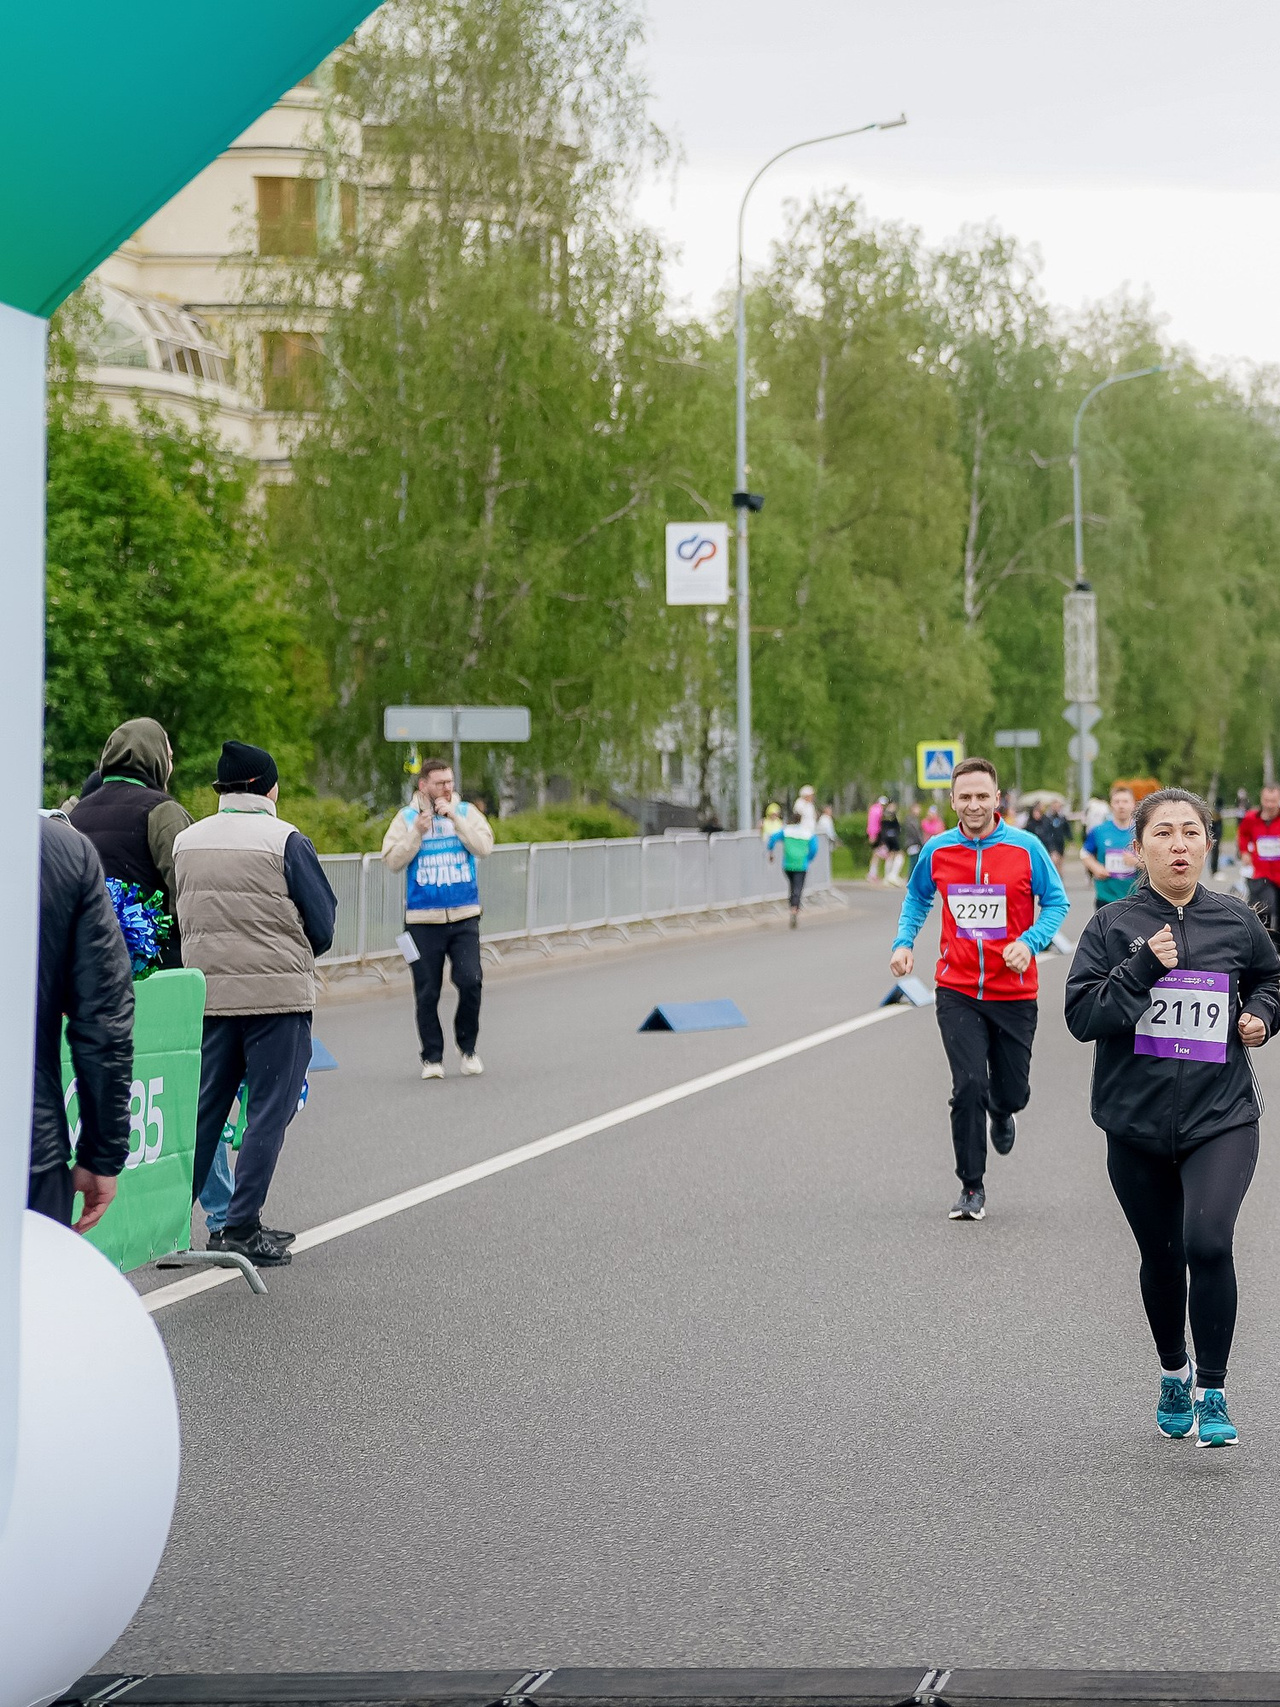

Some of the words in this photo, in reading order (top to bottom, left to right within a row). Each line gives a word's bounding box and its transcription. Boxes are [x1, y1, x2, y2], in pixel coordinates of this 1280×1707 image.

[416, 863, 470, 887] СУДЬЯ
[956, 904, 999, 919] 2297
[1150, 999, 1220, 1029] 2119
